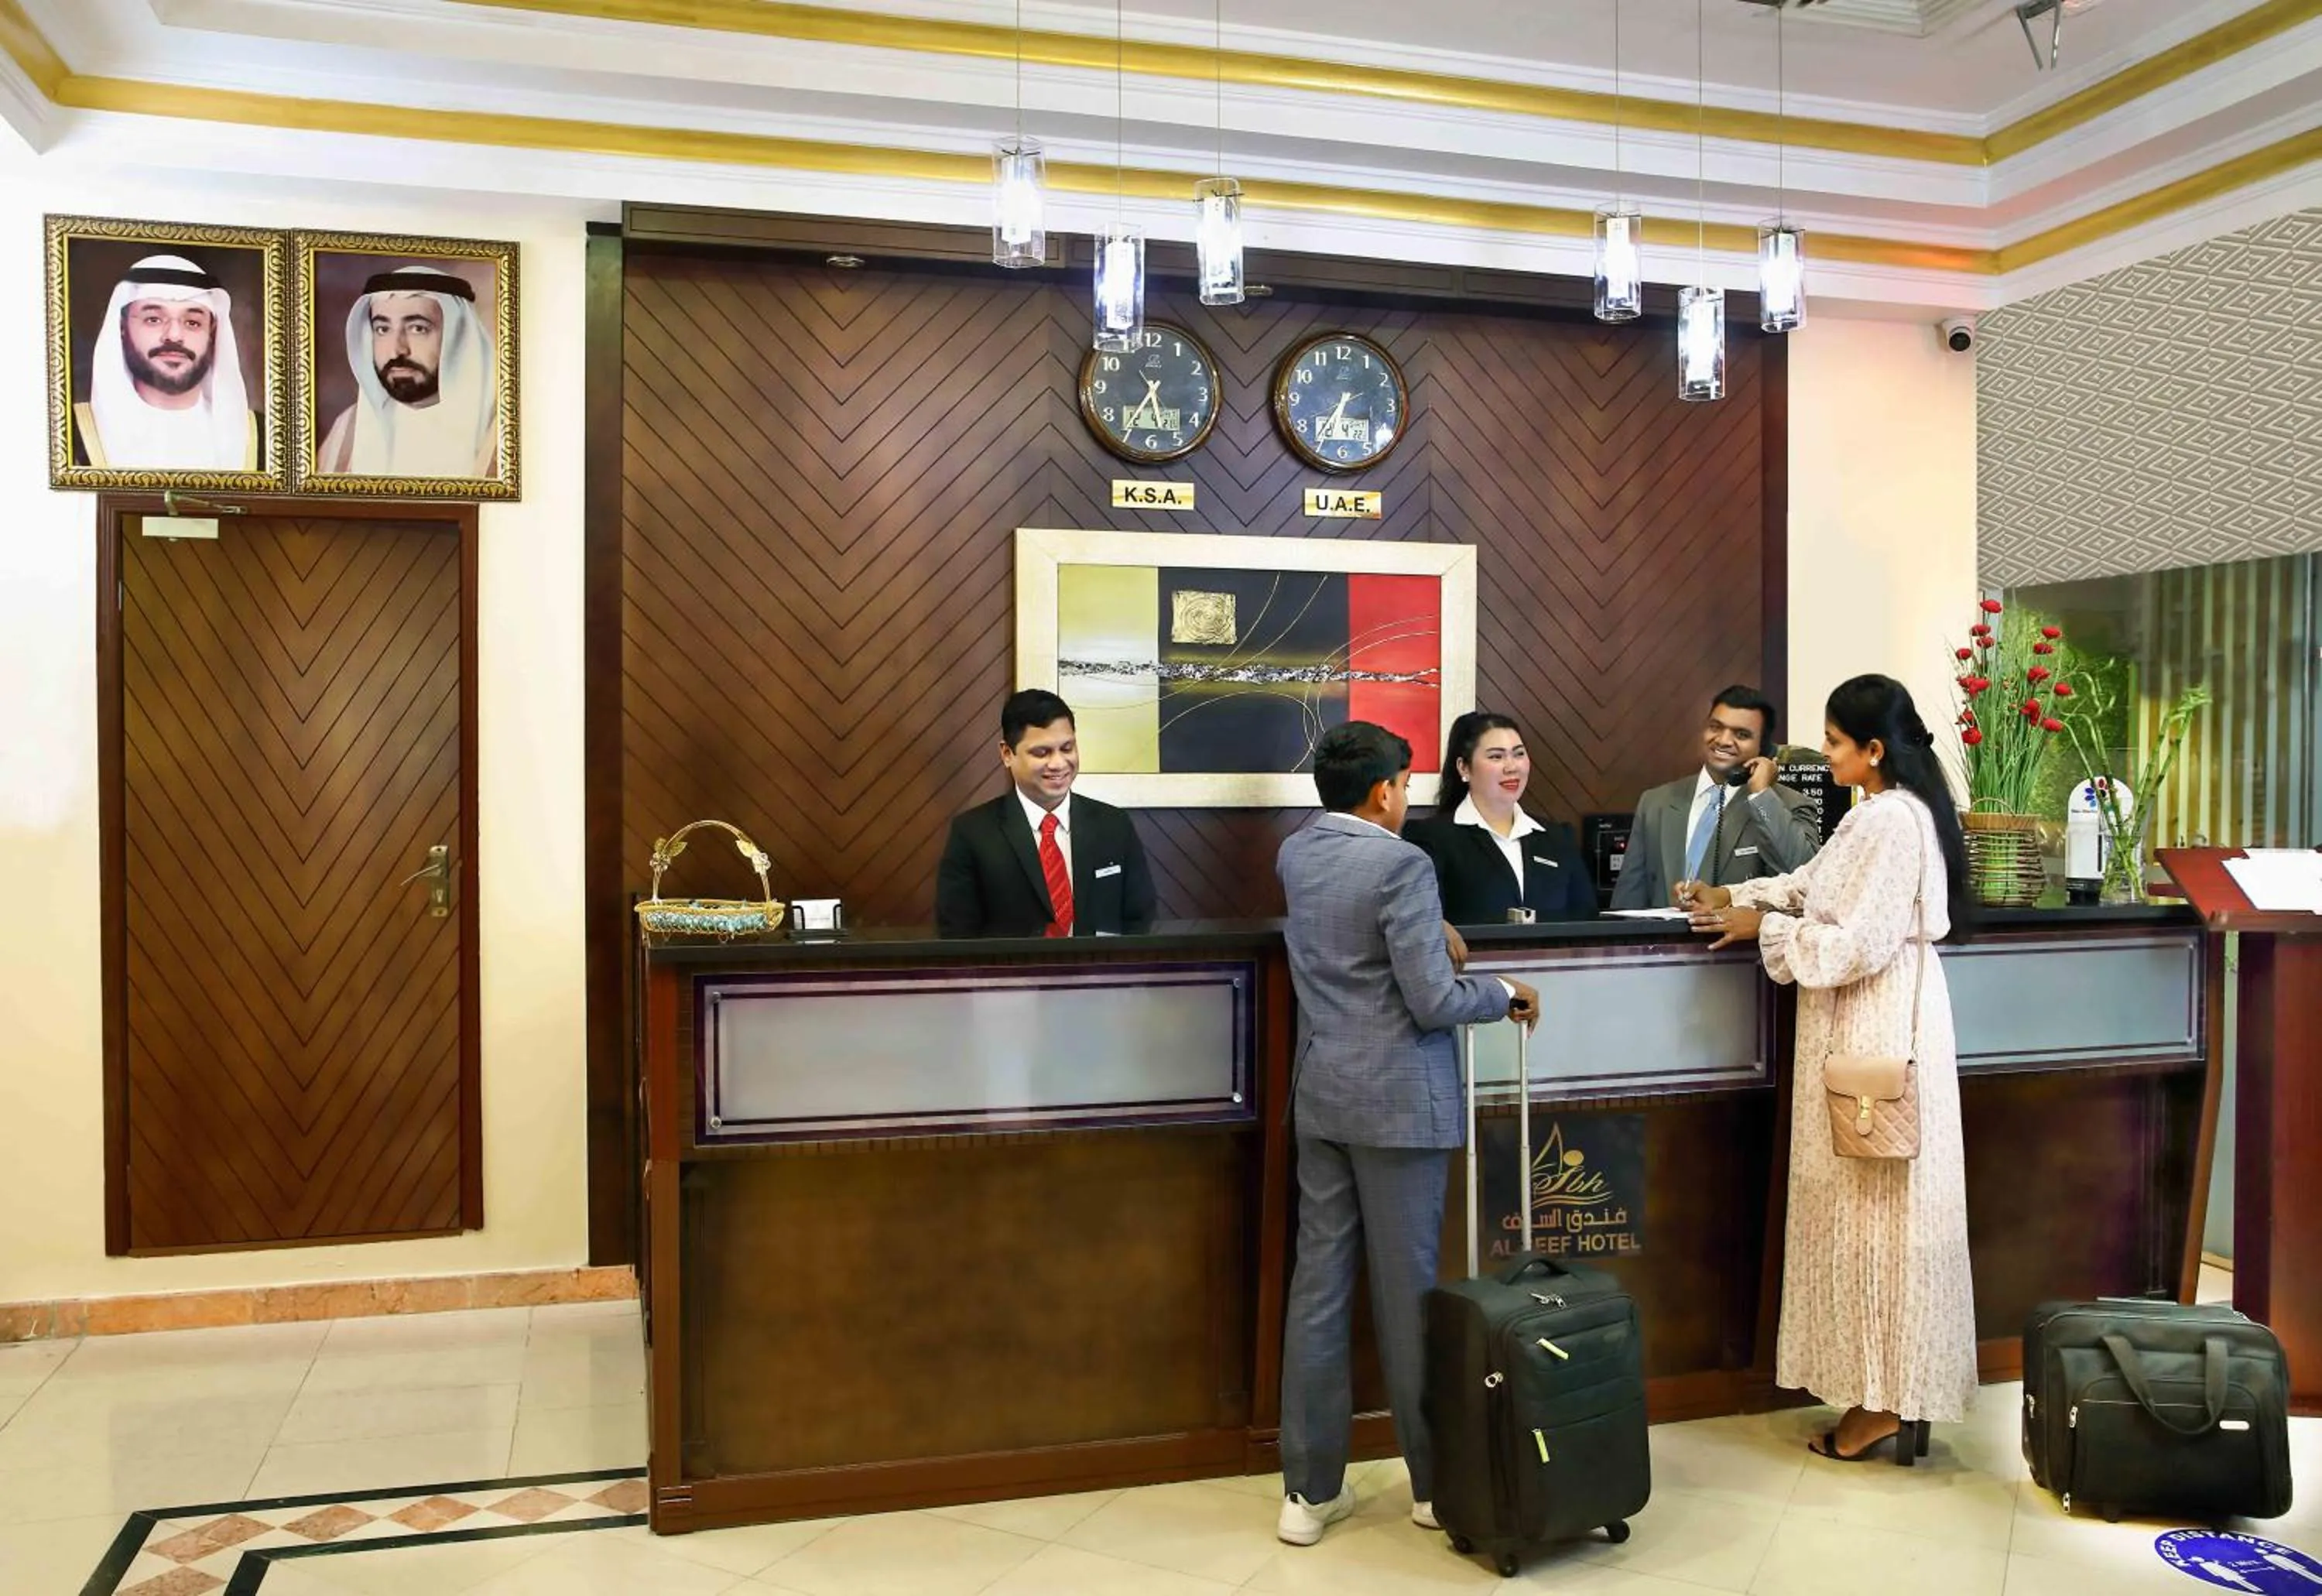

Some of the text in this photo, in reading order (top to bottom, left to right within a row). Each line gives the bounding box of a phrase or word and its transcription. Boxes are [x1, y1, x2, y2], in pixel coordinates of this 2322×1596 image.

[1145, 334, 1162, 348] 12
[1174, 343, 1181, 356] 1
[1335, 346, 1351, 361] 12
[1102, 357, 1120, 372] 10
[1314, 351, 1327, 366] 11
[1363, 354, 1369, 369] 1
[1190, 361, 1202, 375] 2
[1294, 369, 1313, 385] 10
[1378, 373, 1389, 388] 2
[1094, 380, 1107, 394] 9
[1198, 387, 1207, 402] 3
[1289, 392, 1300, 406] 9
[1386, 399, 1396, 413] 3
[1102, 407, 1115, 422] 8
[1189, 412, 1199, 428] 4
[1296, 419, 1308, 433] 8
[1146, 434, 1157, 449] 6
[1173, 432, 1183, 446] 5
[1337, 446, 1348, 458] 6
[1361, 442, 1372, 456] 5
[1125, 487, 1182, 505] K.S.A.
[1316, 495, 1370, 513] U.A.E.
[1802, 773, 1823, 782] RATE
[1566, 1207, 1627, 1233] فندق
[1490, 1234, 1642, 1258] AL EEF HOTEL
[2160, 1530, 2293, 1567] KEEP DISTANCE
